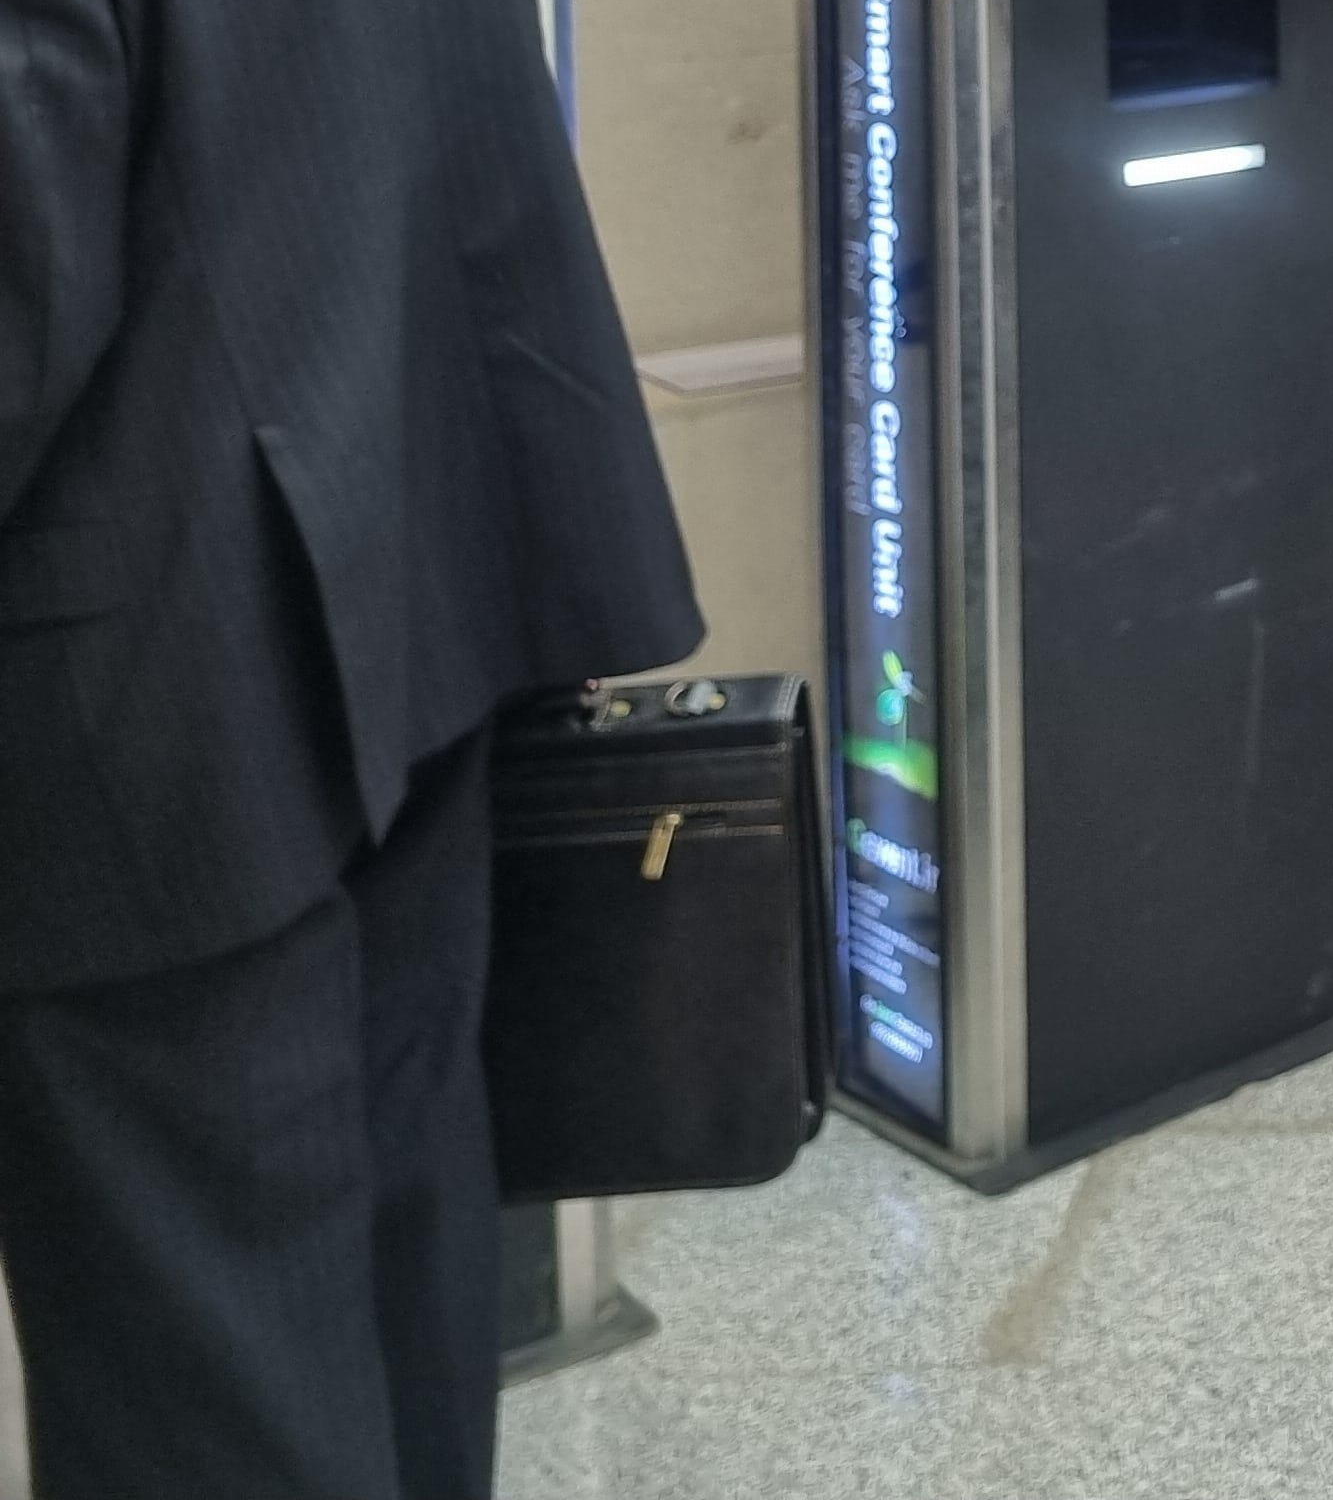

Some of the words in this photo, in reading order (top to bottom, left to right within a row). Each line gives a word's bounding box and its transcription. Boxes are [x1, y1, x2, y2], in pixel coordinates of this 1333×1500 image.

[867, 122, 900, 393] Conference
[870, 400, 903, 515] Card
[872, 518, 904, 619] Unit
